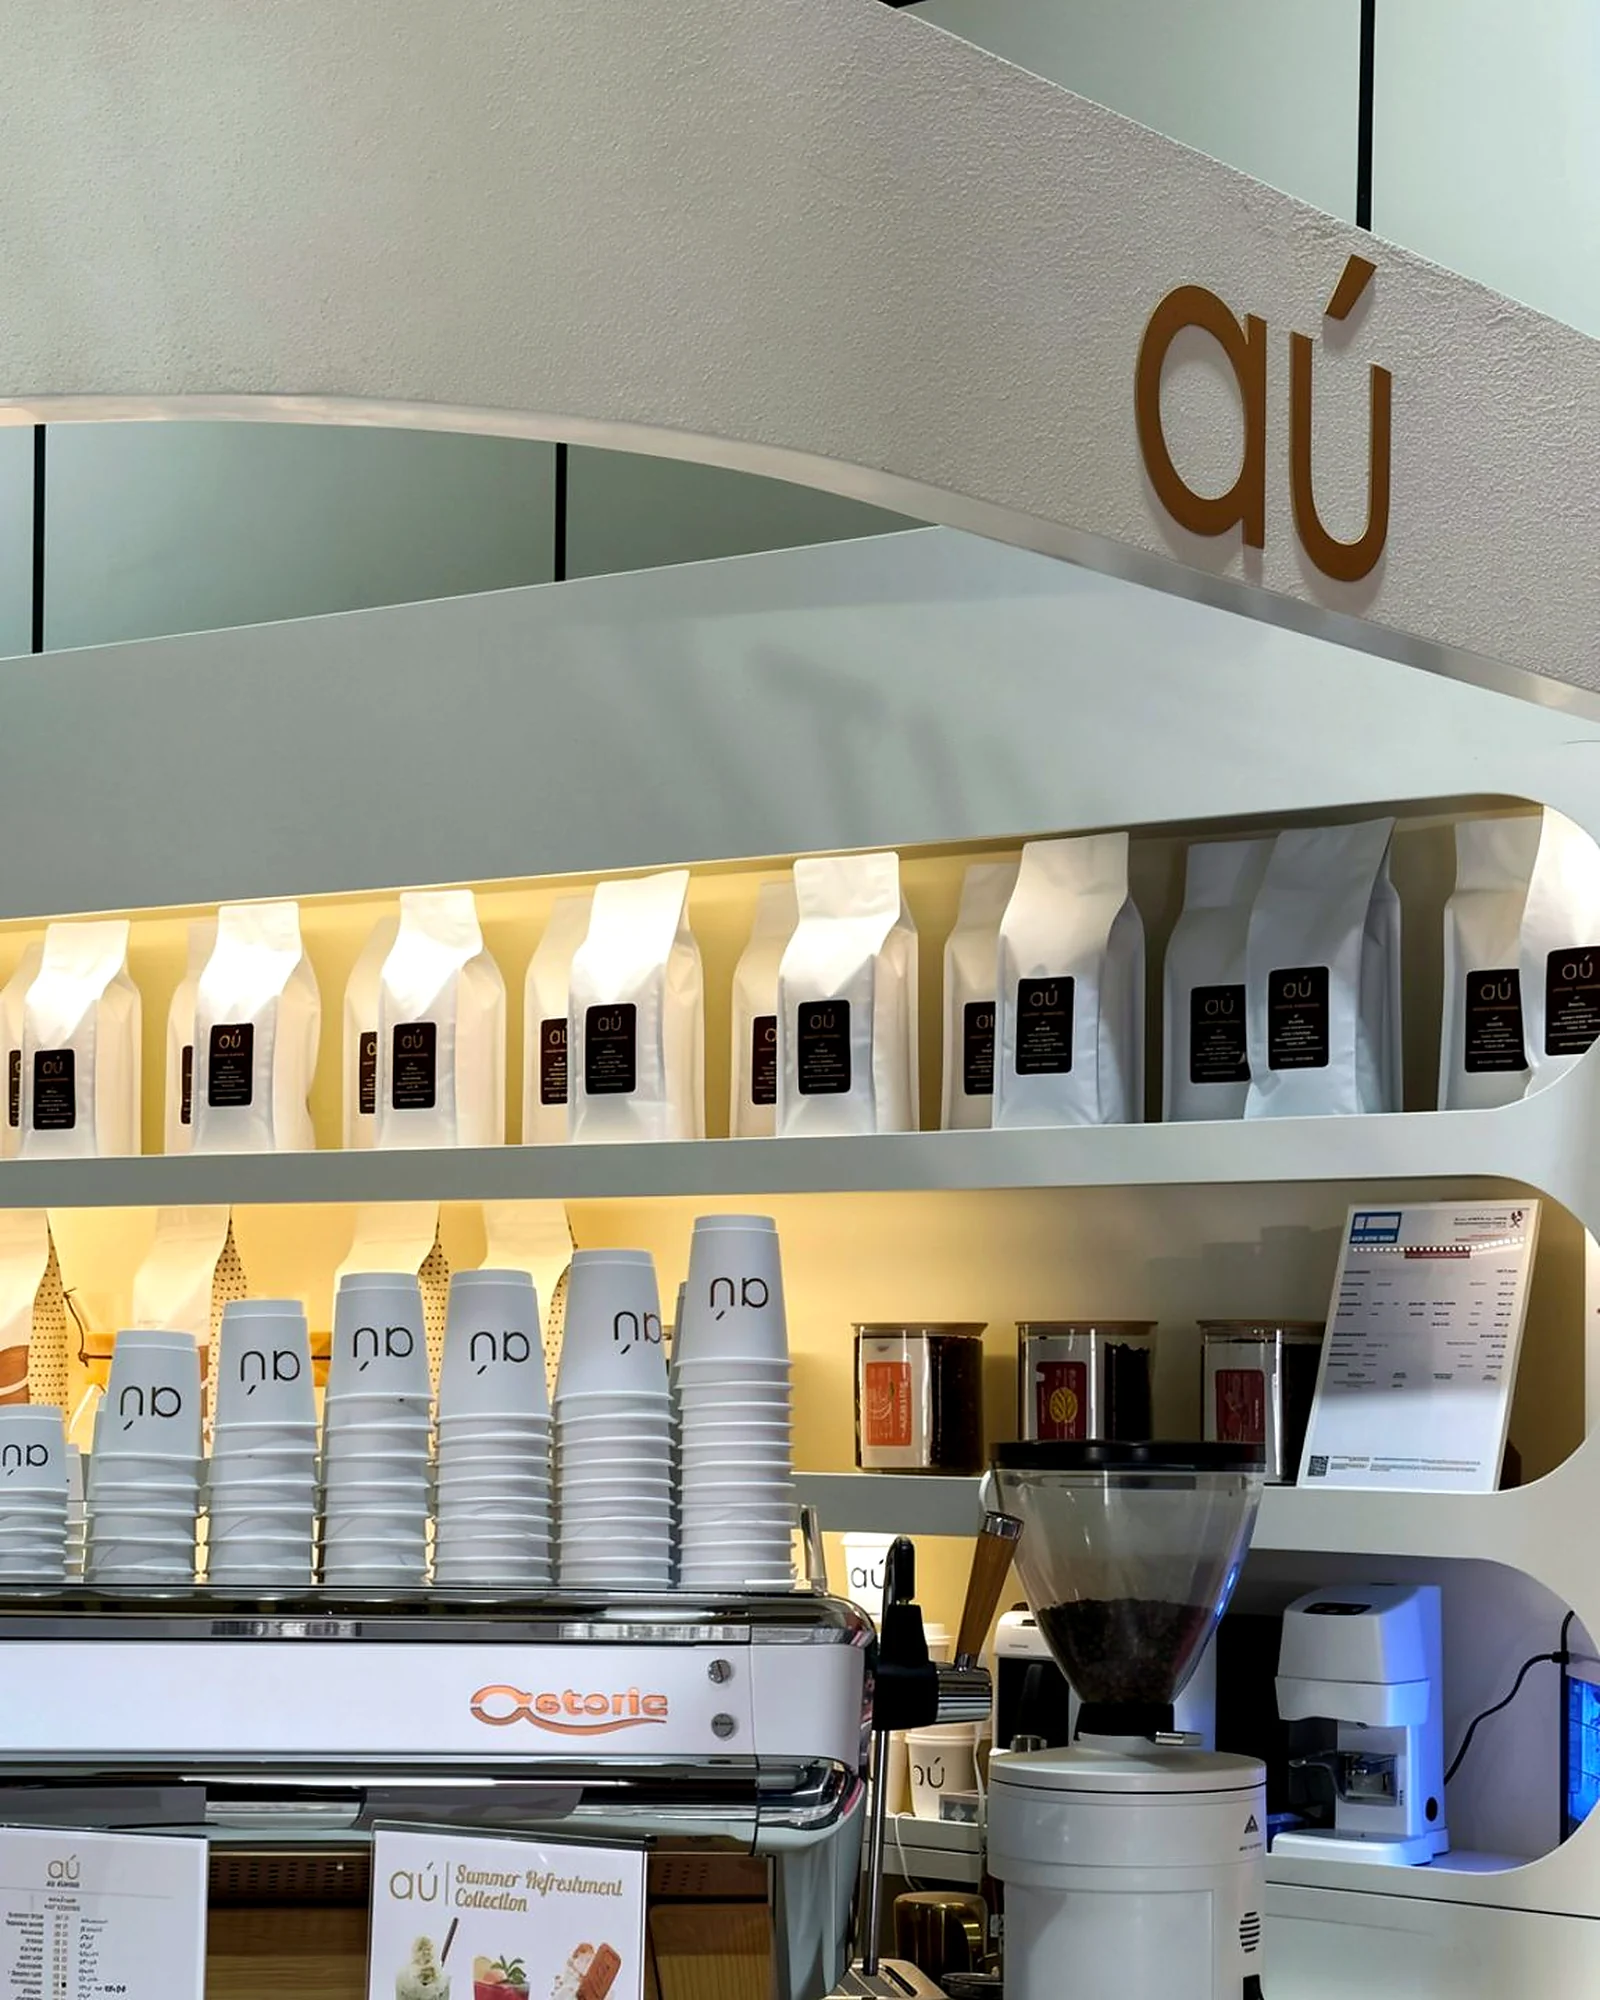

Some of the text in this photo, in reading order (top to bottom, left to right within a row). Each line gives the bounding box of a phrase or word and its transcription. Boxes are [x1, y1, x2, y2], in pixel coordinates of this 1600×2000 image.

[1134, 254, 1392, 582] aú
[389, 1861, 623, 1902] aú Summer Refreshment
[455, 1888, 528, 1912] Collection
